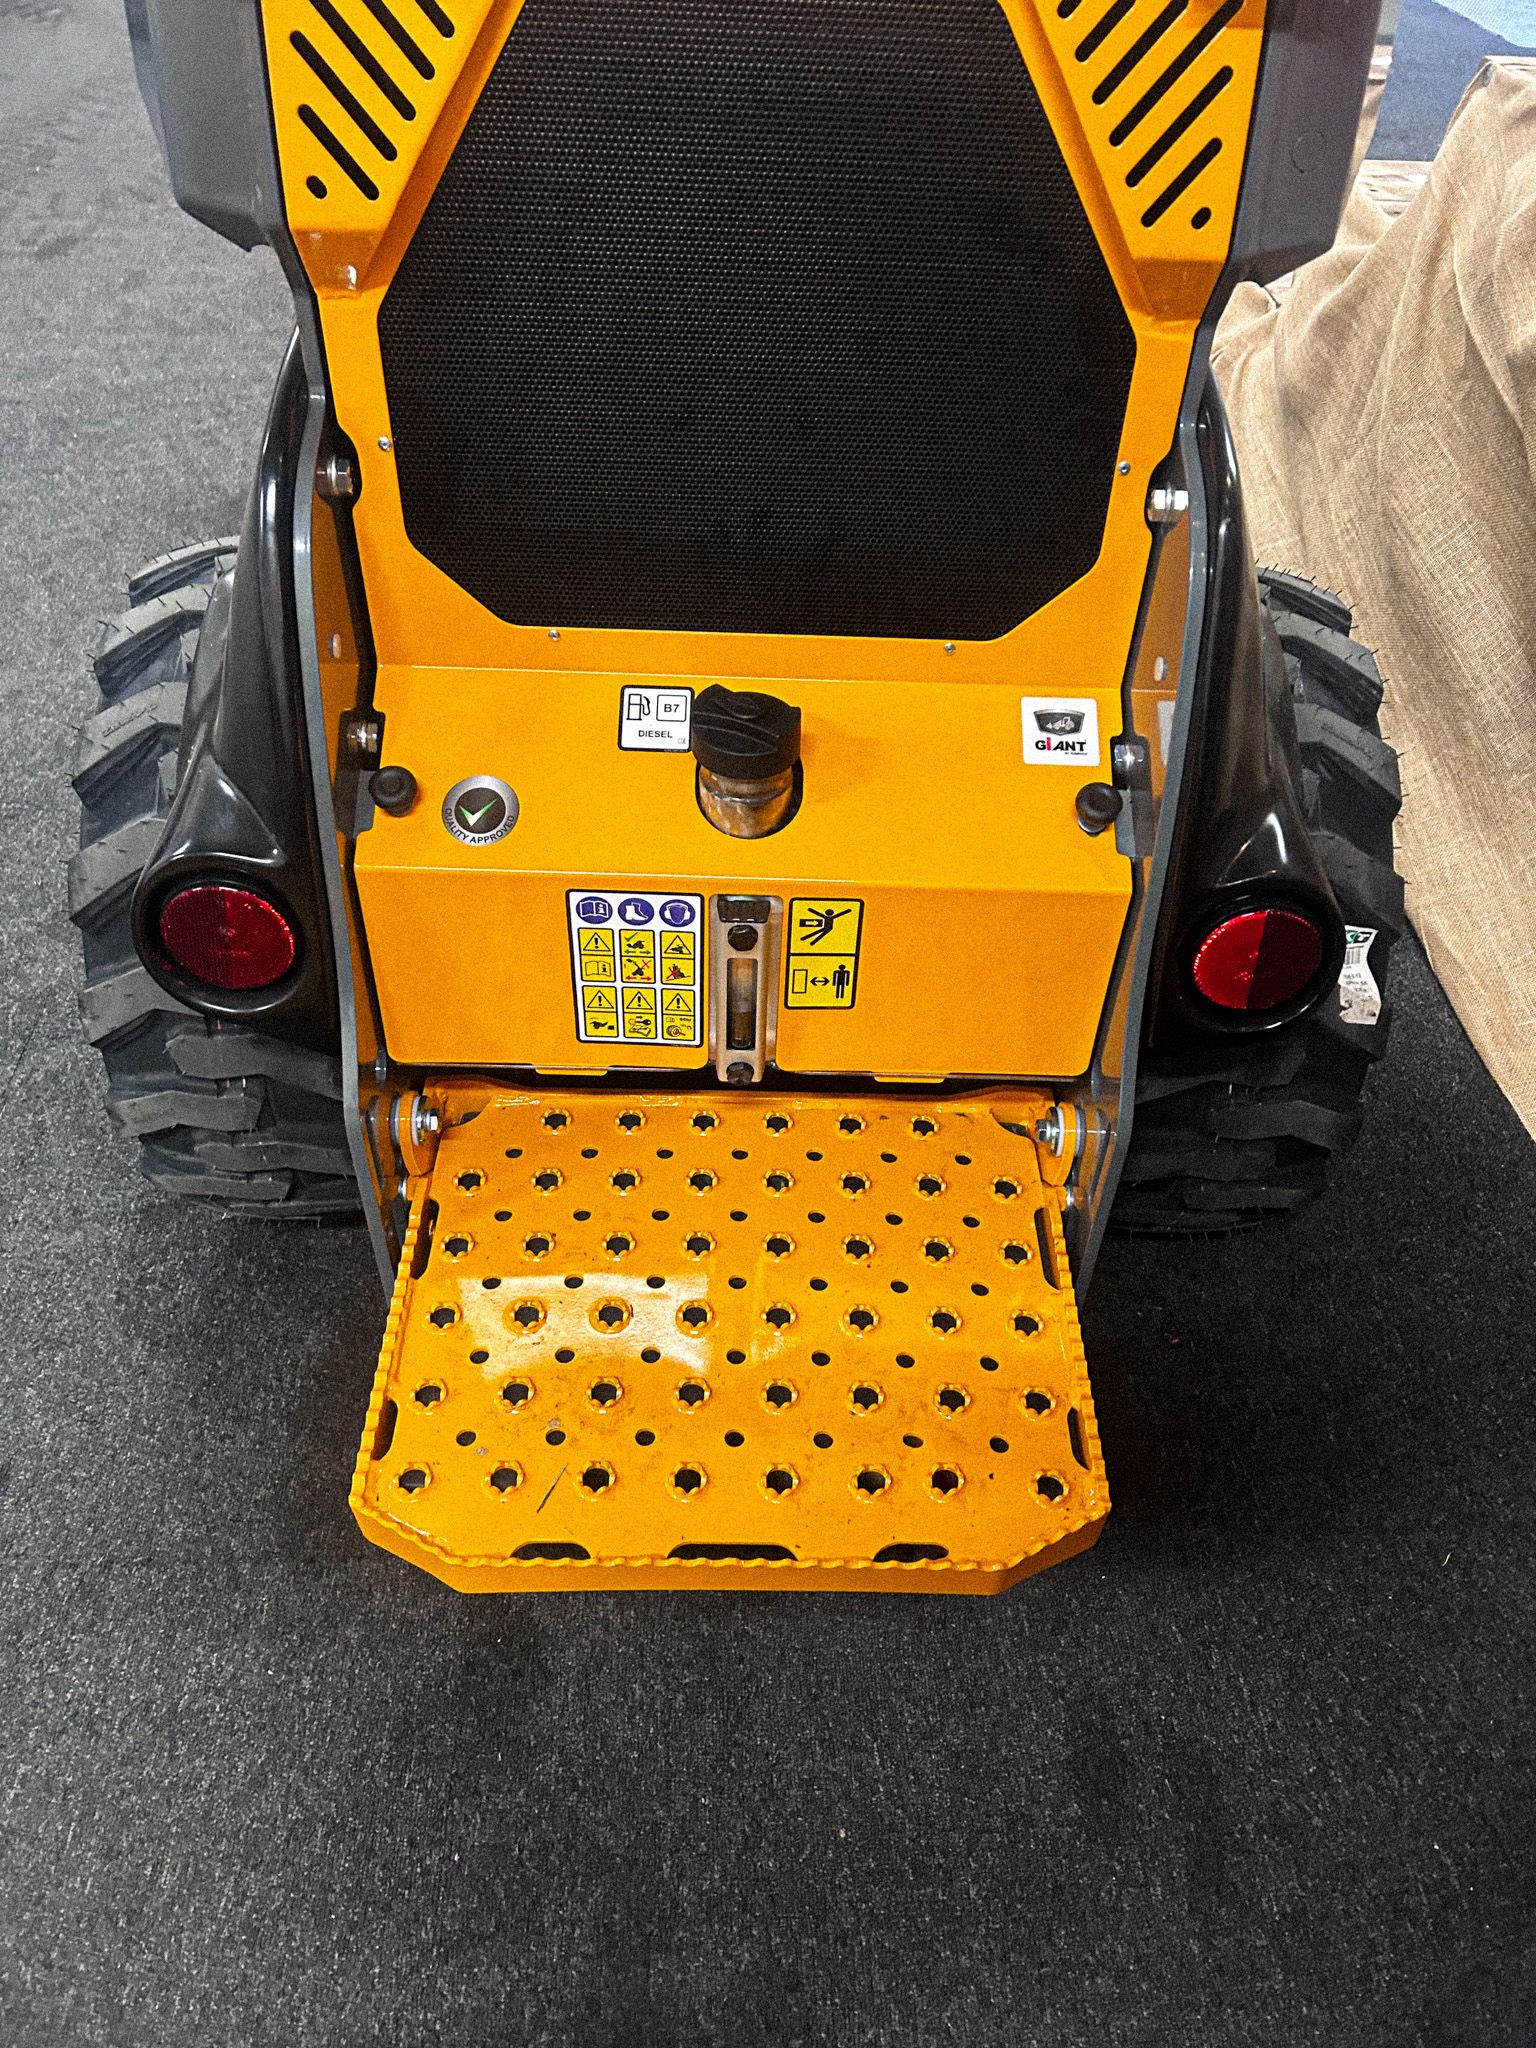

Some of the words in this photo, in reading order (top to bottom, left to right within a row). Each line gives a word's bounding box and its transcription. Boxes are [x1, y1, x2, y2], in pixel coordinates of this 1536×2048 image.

[663, 703, 680, 713] B7
[638, 729, 673, 739] DIESEL
[1035, 737, 1087, 752] GIANT
[444, 807, 470, 840] QUALITY
[470, 815, 515, 844] APPROVED
